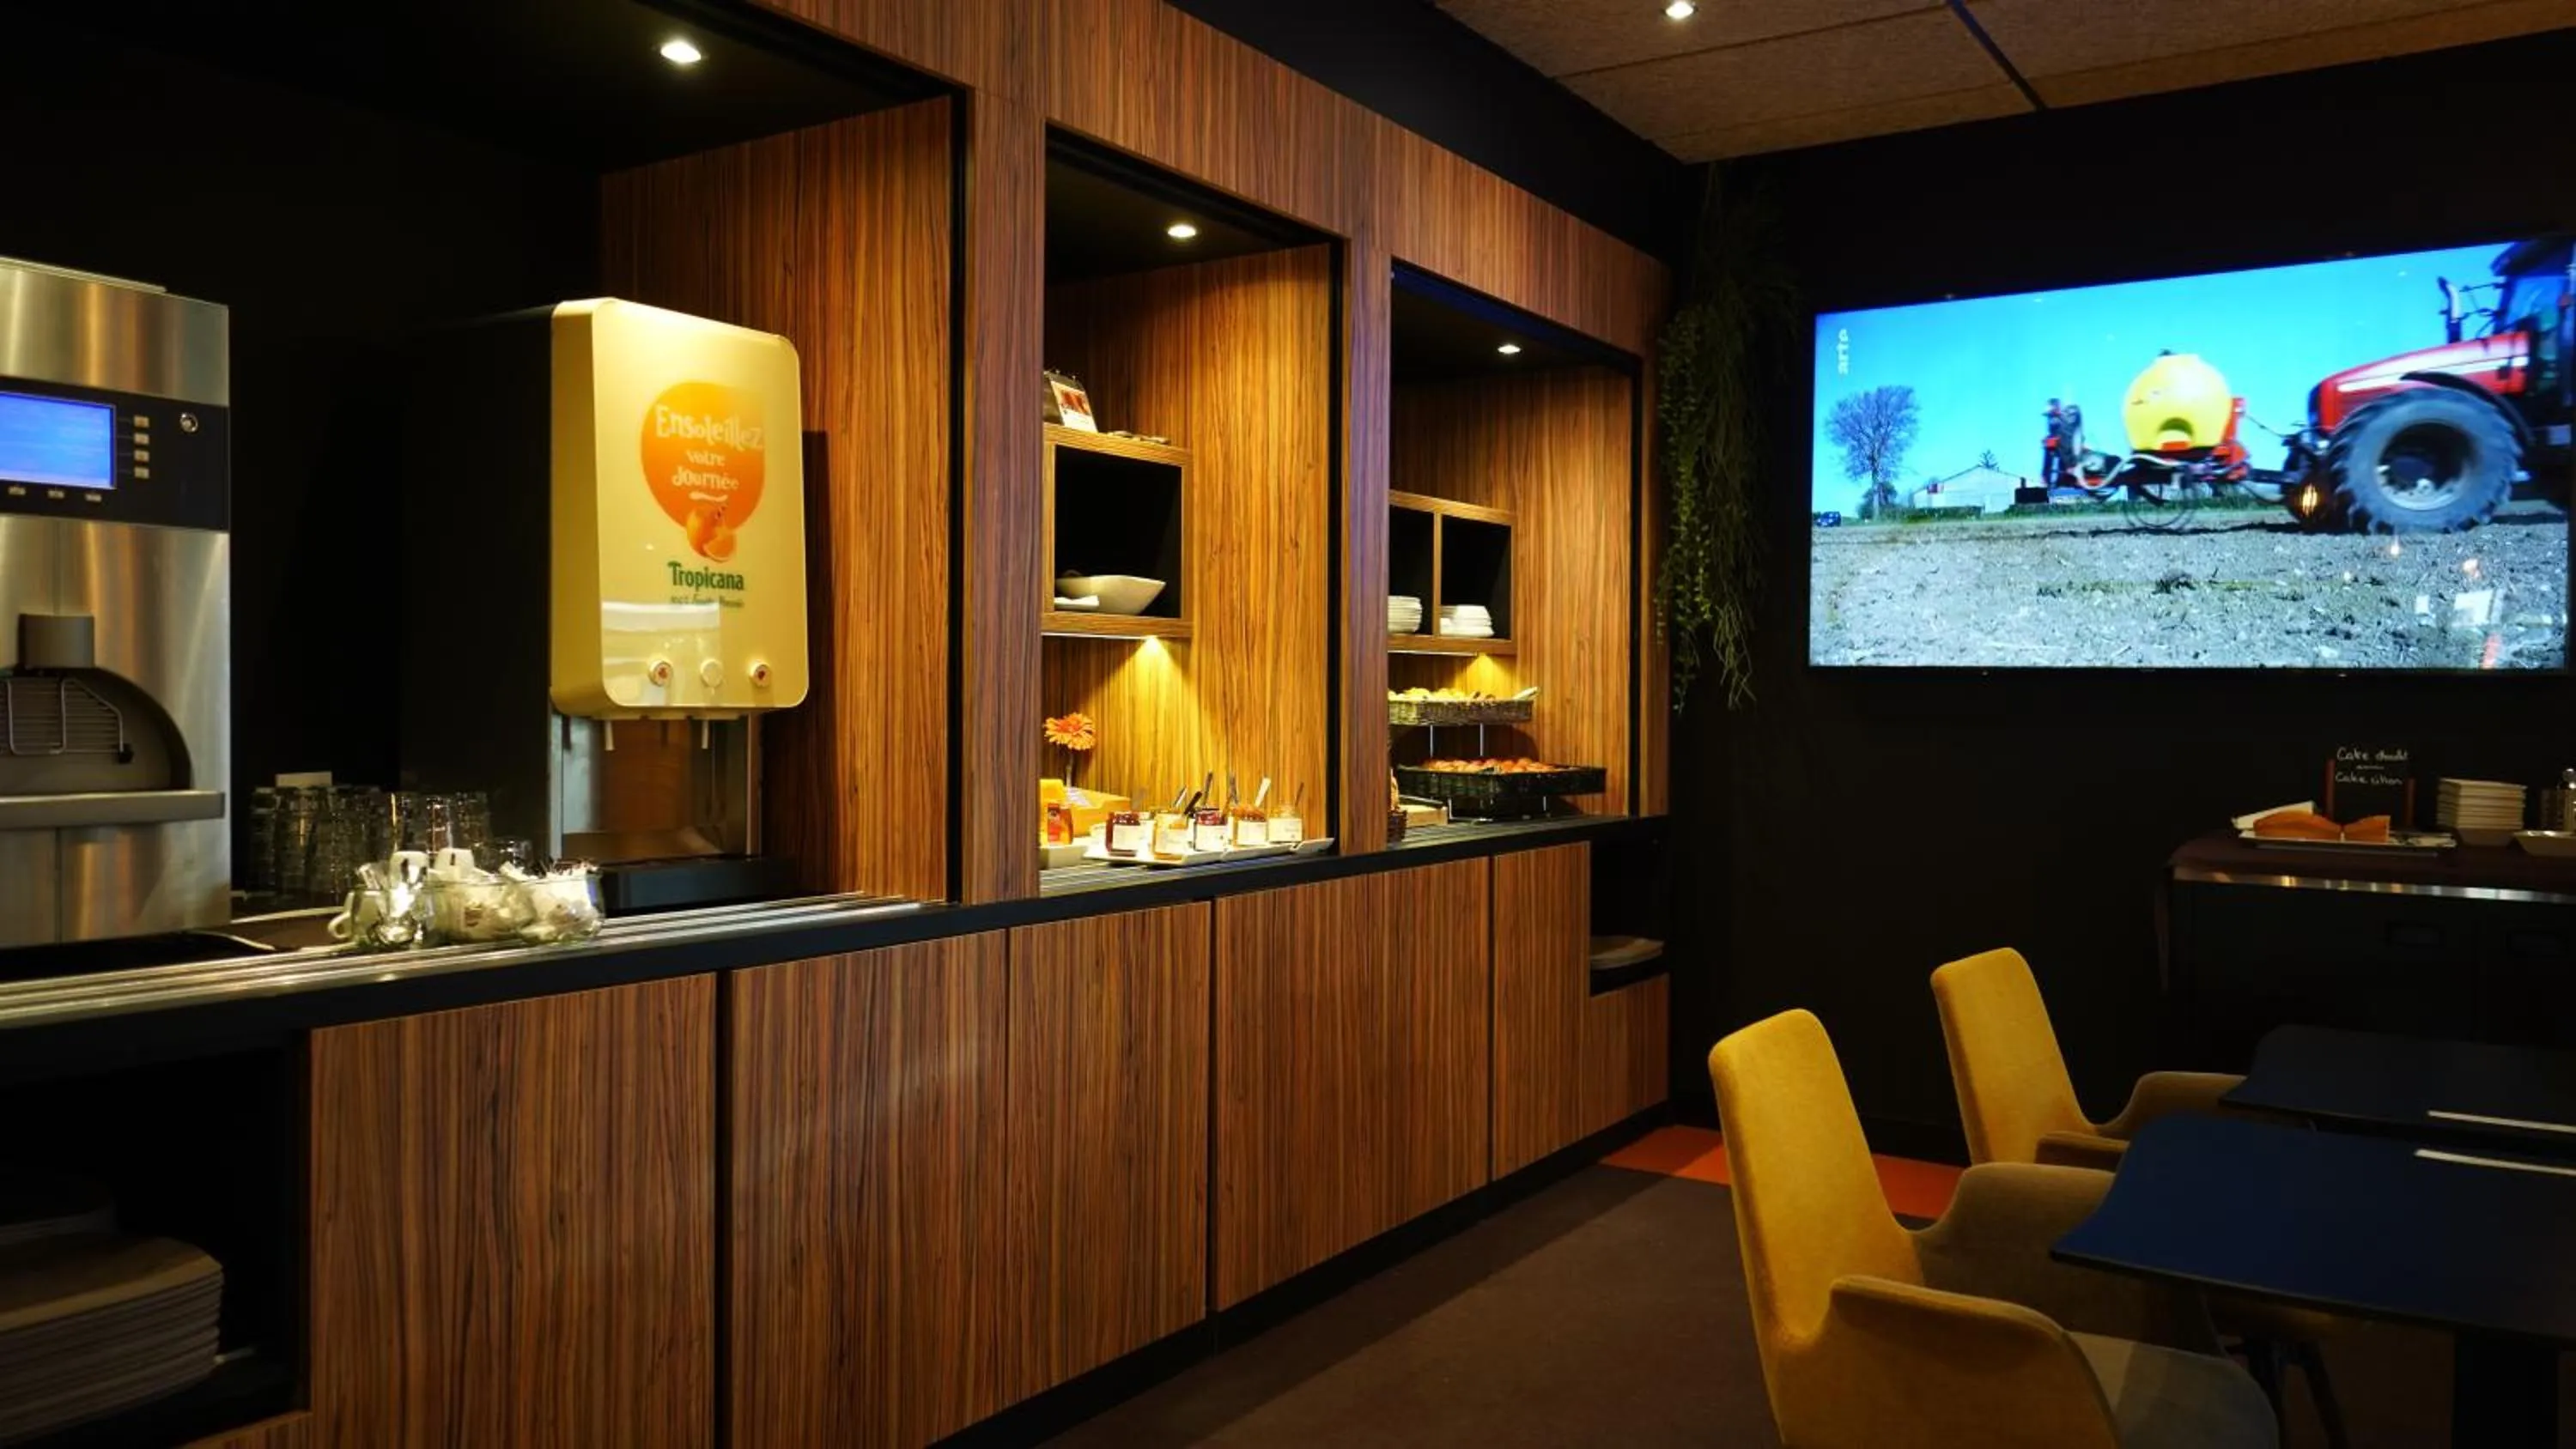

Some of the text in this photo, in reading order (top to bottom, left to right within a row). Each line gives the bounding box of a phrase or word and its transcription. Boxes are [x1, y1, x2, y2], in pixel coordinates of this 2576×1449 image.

[667, 561, 744, 591] Tropicana
[2336, 746, 2369, 761] Cake
[2335, 771, 2368, 784] Cake
